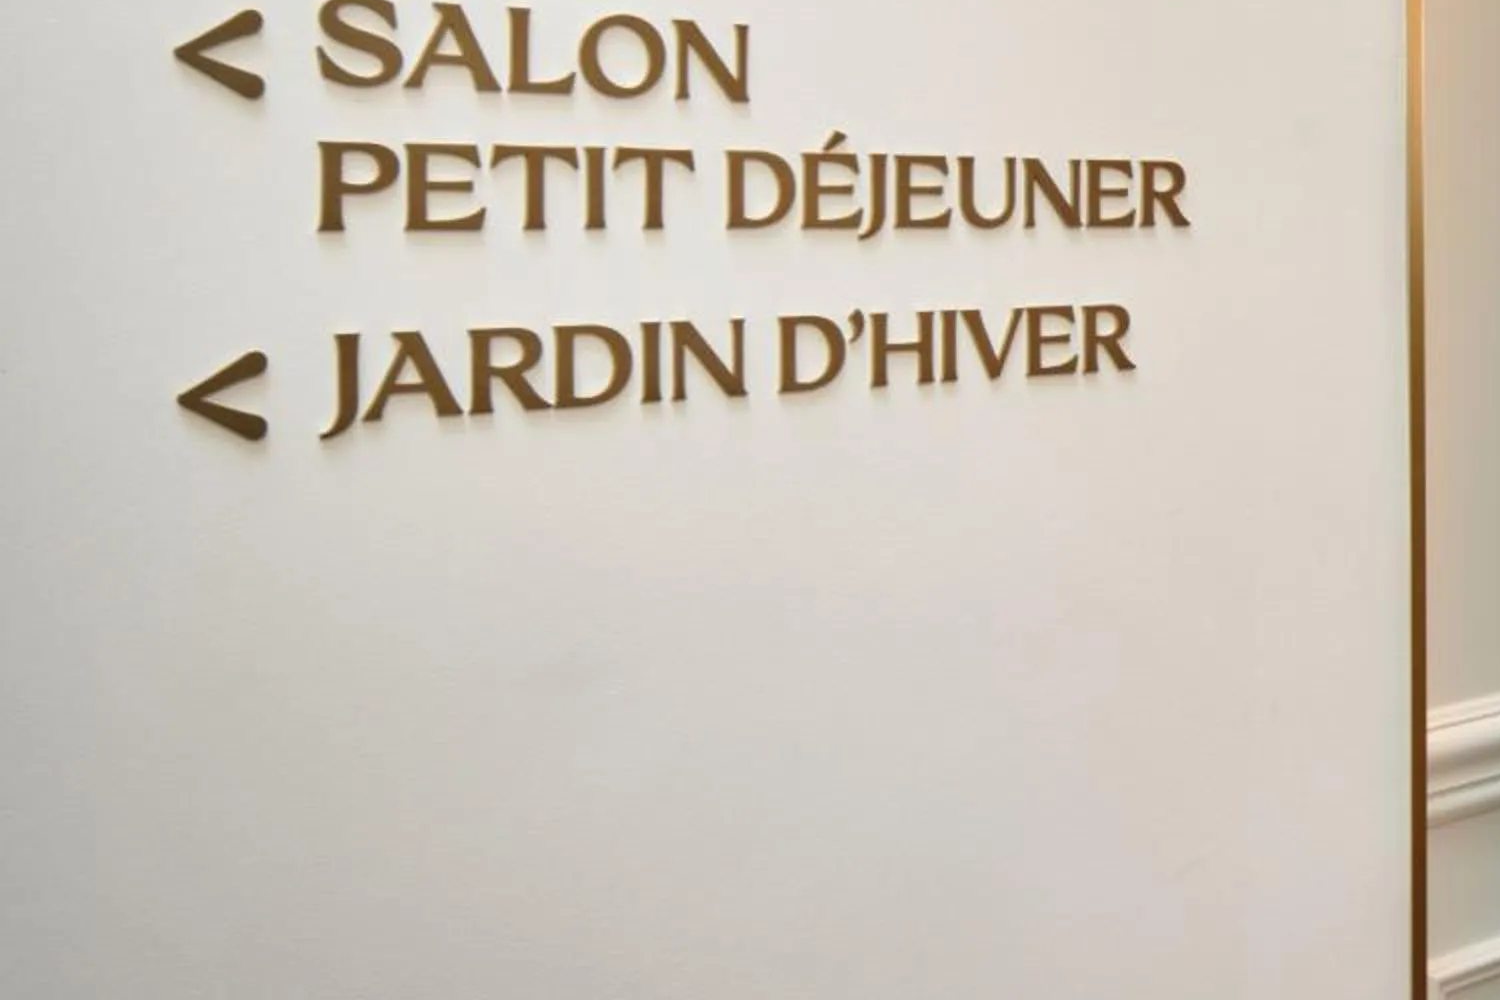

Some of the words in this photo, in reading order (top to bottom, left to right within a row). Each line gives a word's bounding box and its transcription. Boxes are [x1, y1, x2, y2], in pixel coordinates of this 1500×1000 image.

[317, 140, 696, 234] PETIT
[726, 130, 1192, 242] DÉJEUNER
[318, 318, 749, 442] JARDIN
